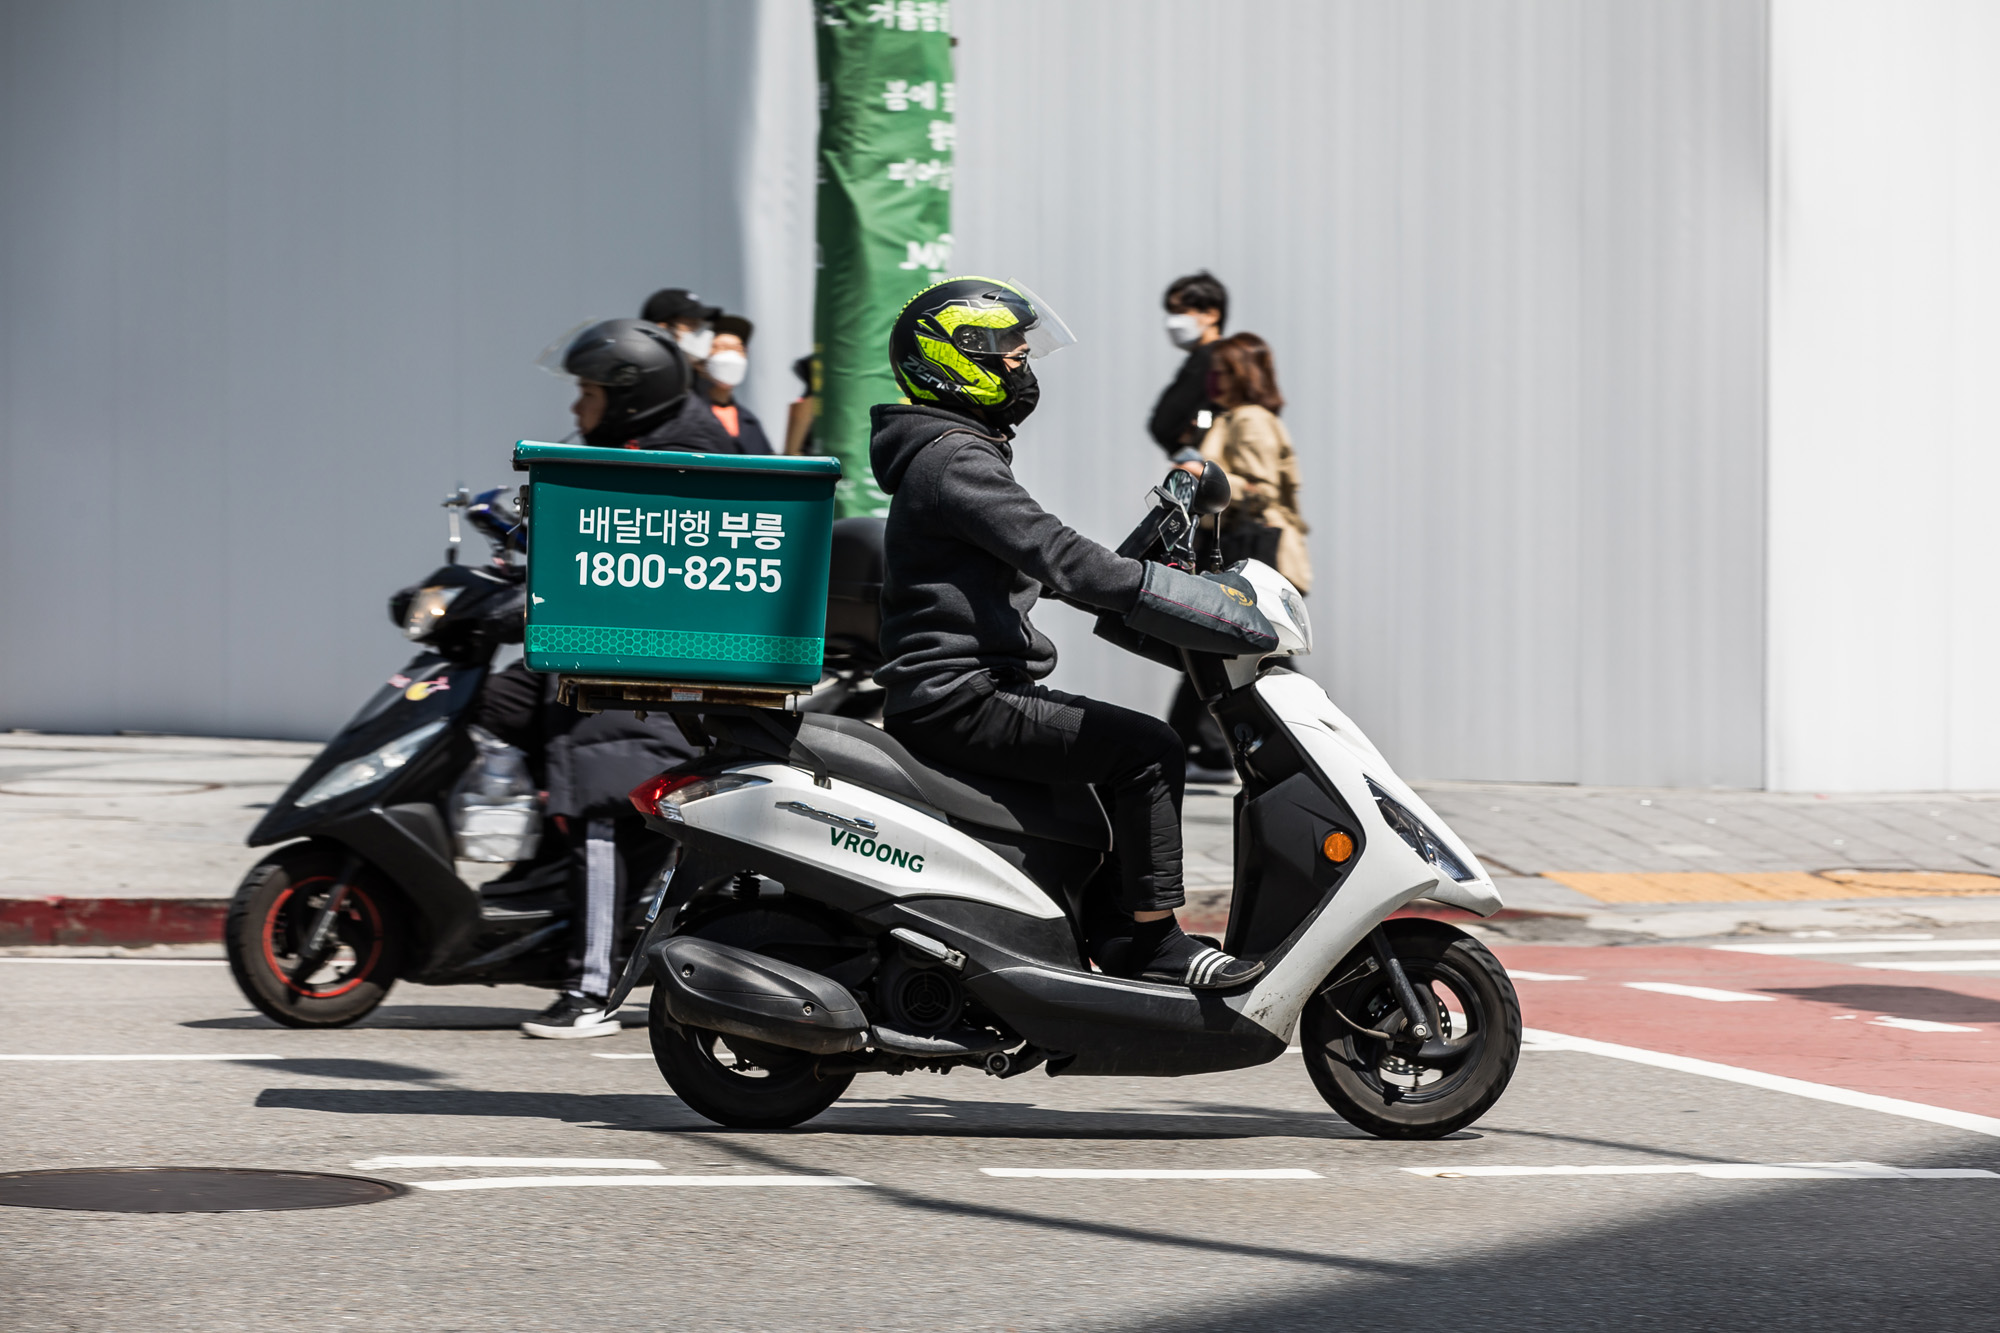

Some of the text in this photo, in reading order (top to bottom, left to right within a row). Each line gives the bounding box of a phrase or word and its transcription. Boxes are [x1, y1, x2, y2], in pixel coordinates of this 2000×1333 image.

[579, 506, 785, 550] 배달대행 부릉
[575, 551, 782, 593] 1800-8255
[830, 826, 925, 873] VROONG
